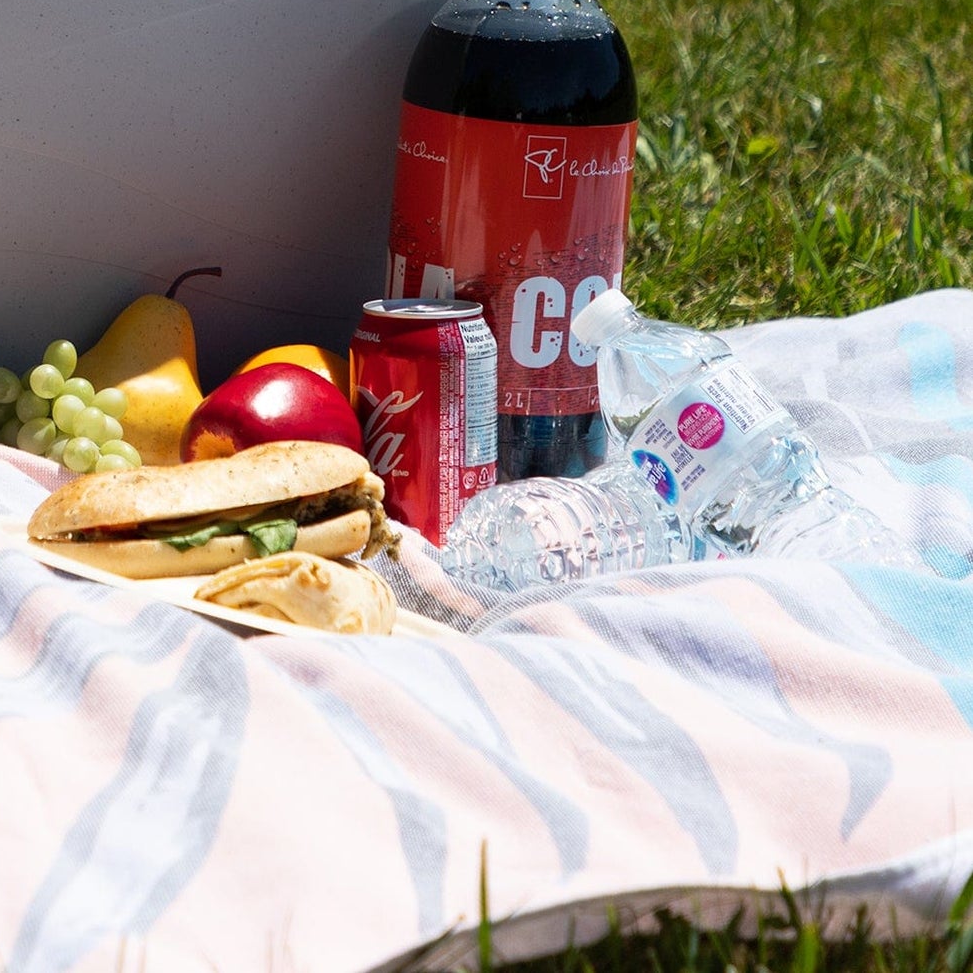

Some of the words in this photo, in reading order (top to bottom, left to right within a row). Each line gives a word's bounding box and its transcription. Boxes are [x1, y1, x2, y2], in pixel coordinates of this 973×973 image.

[505, 392, 513, 407] 2
[516, 393, 523, 407] L
[706, 385, 724, 403] Facts
[712, 378, 736, 403] nutritive
[678, 415, 695, 431] PURE
[690, 405, 706, 419] LIFE
[722, 402, 749, 430] Nutrition
[735, 403, 754, 425] Valeur
[651, 462, 666, 479] Life
